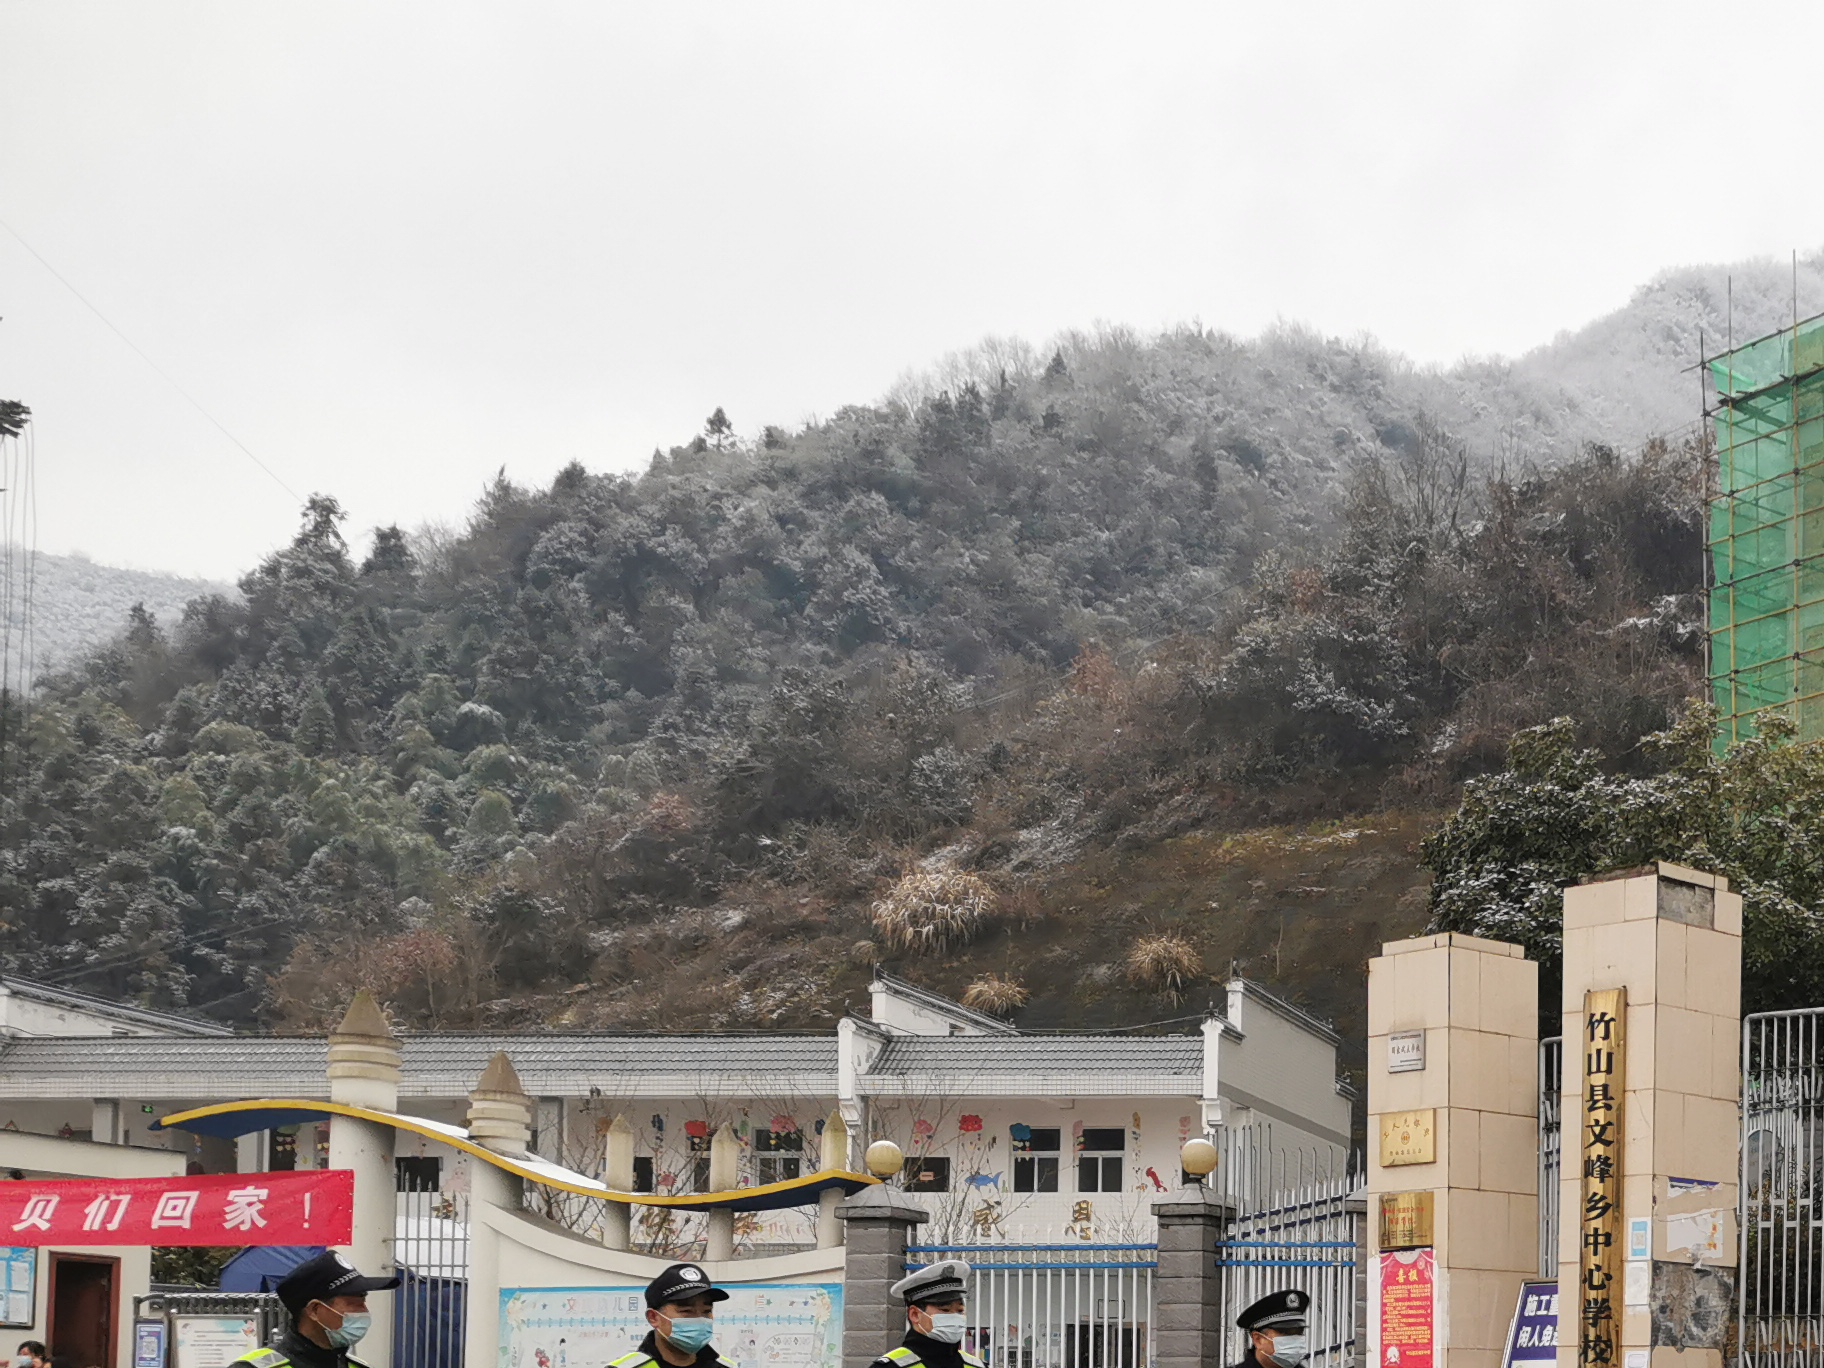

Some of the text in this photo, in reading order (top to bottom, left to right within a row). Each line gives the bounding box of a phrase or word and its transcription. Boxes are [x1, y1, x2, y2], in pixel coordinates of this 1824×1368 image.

[1579, 1012, 1616, 1366] 竹山县文峰乡中心学校
